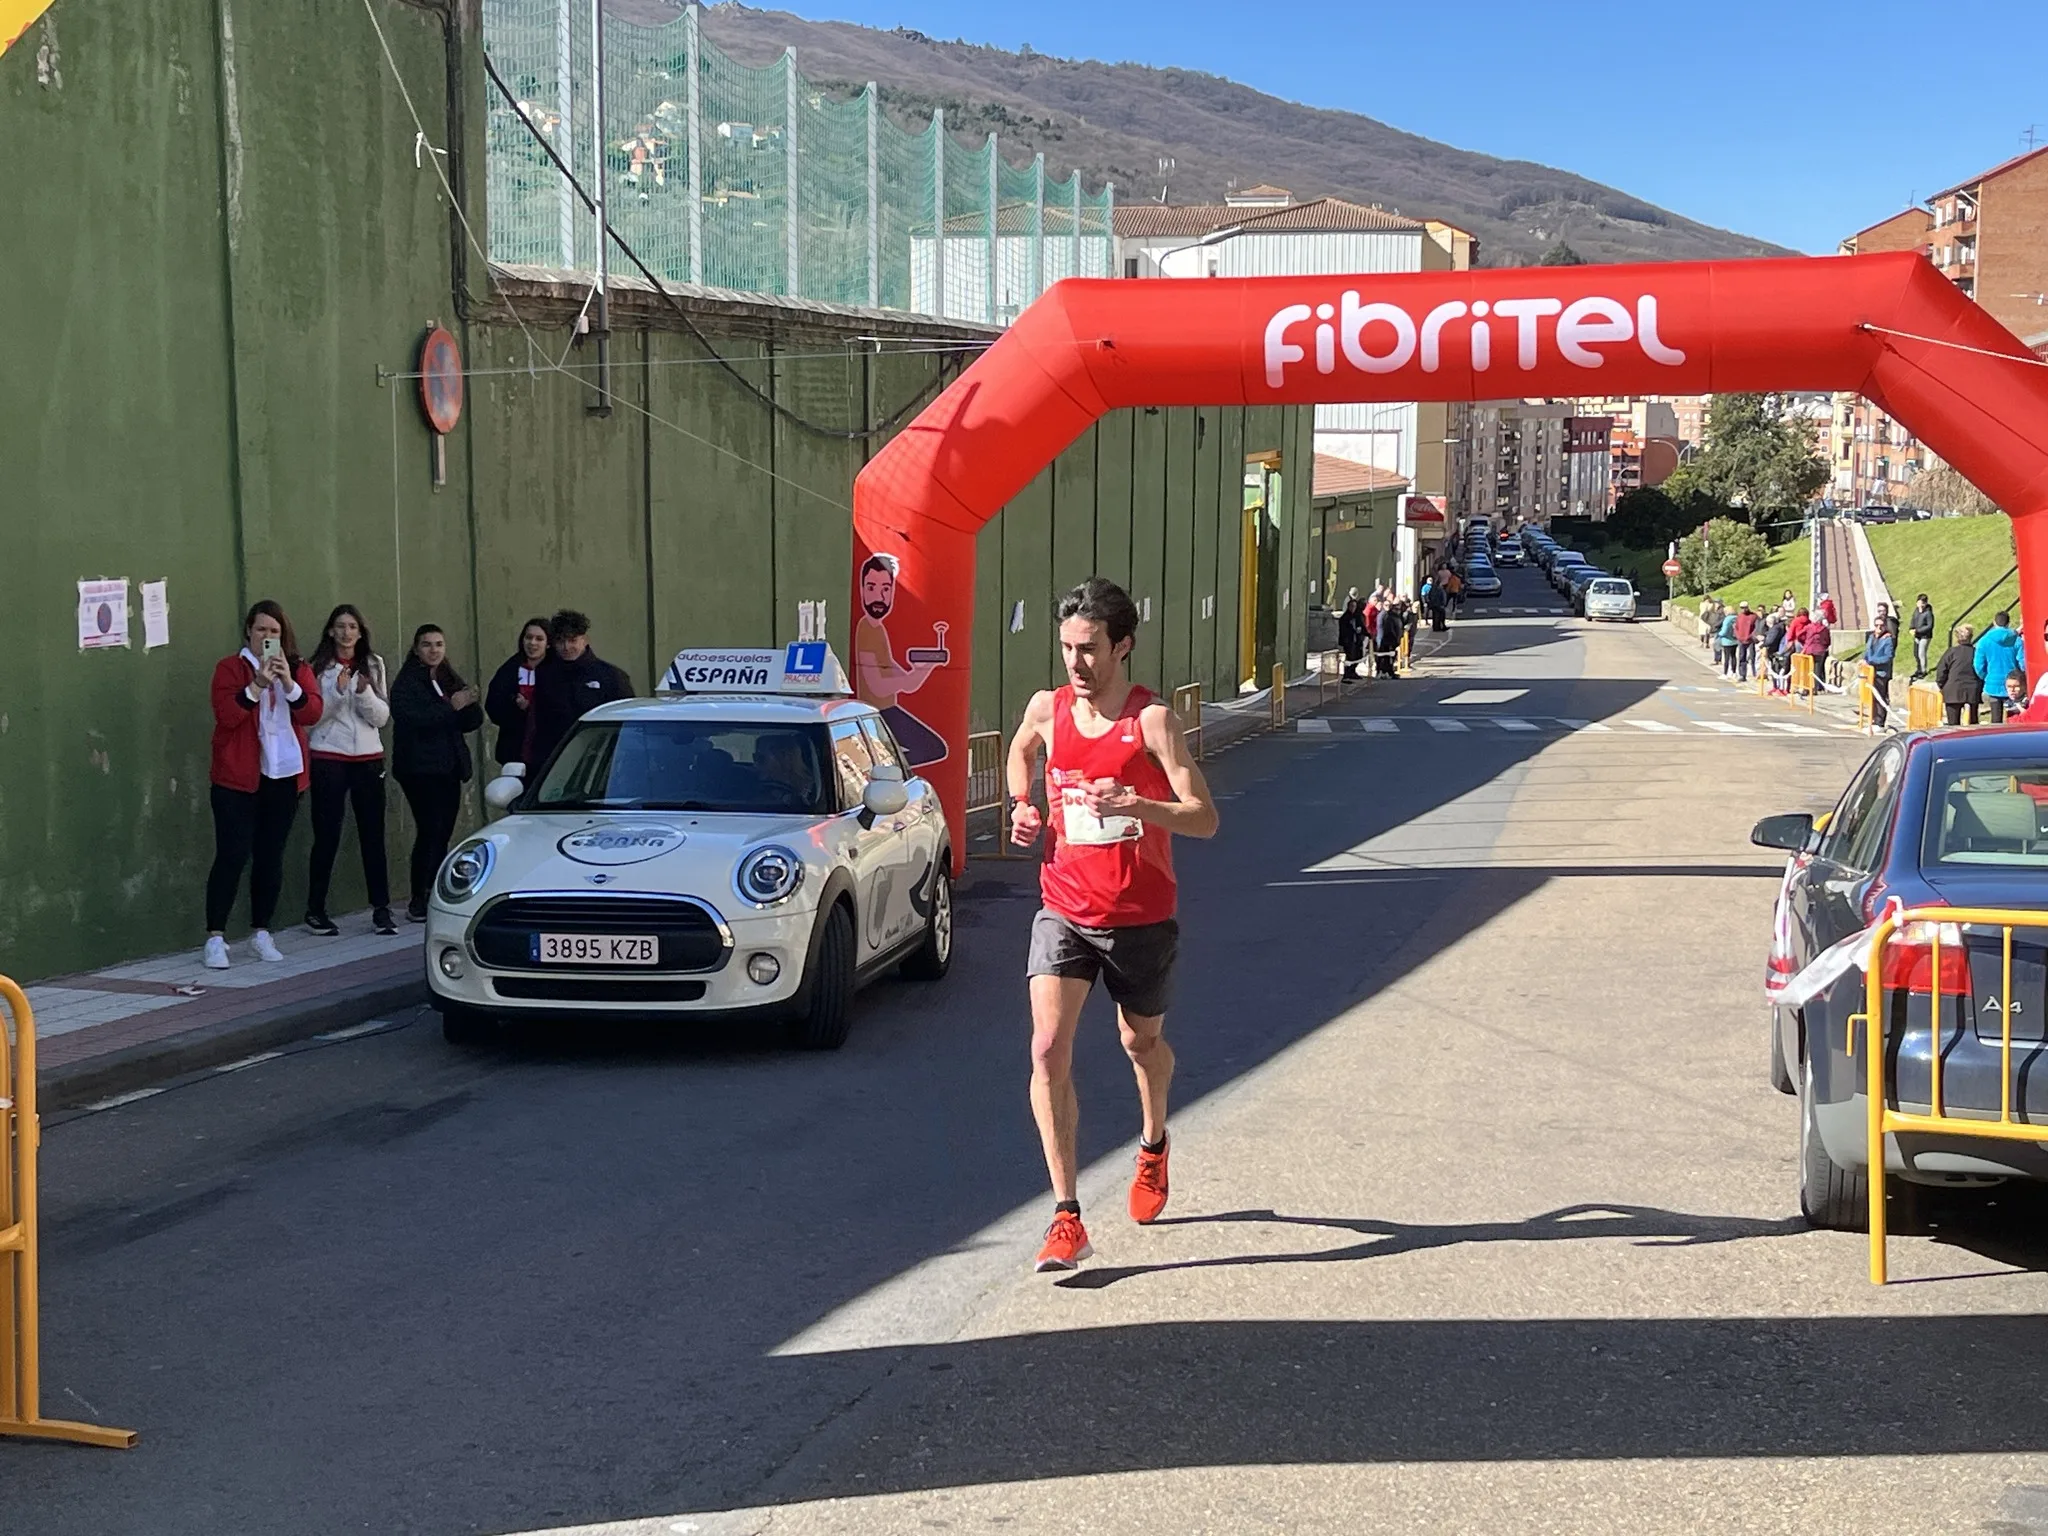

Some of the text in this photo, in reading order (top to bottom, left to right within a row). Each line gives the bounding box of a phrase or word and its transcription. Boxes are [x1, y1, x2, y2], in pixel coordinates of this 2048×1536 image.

[678, 653, 772, 663] autoescuelas
[794, 648, 814, 670] L
[685, 666, 768, 685] ESPAÑA
[546, 938, 652, 960] 3895 KZB
[1981, 995, 2023, 1013] A4
